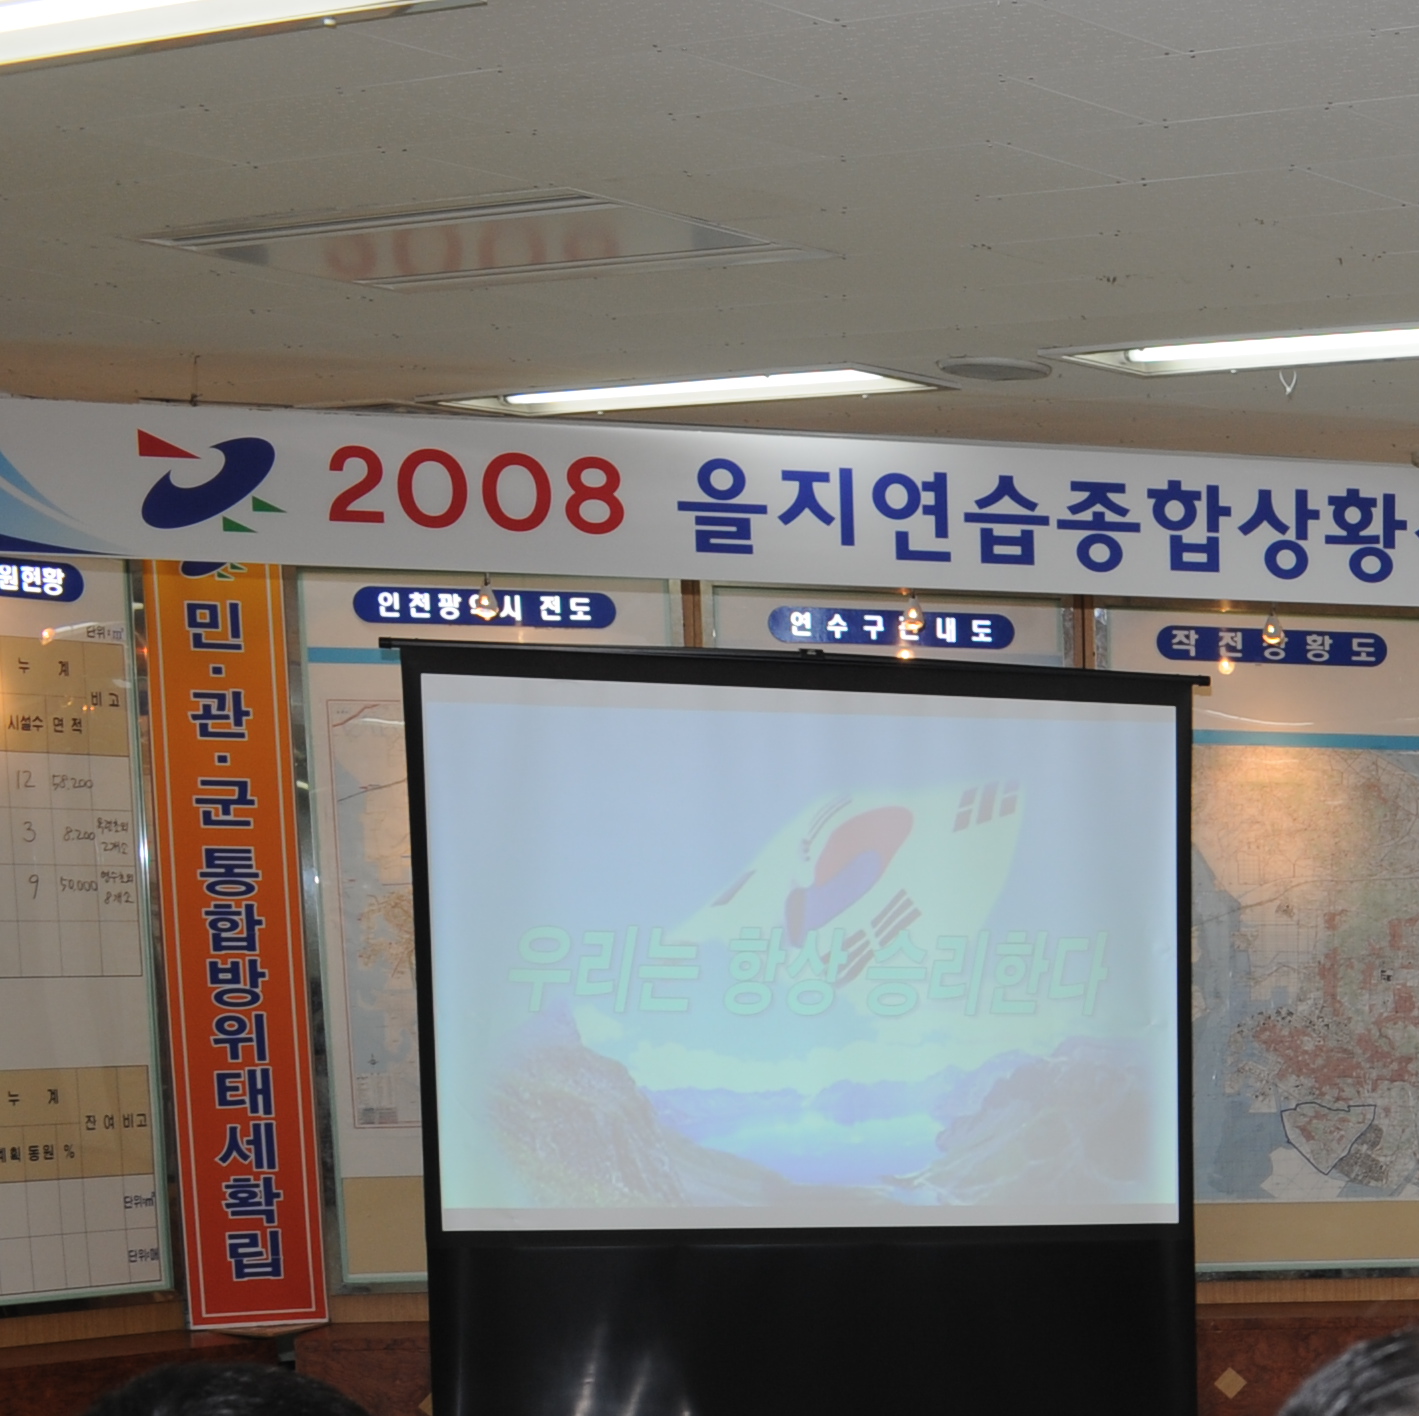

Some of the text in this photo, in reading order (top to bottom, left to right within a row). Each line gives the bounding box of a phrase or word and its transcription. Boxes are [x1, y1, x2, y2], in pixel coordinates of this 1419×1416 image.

[328, 444, 625, 535] 2008
[8, 715, 44, 732] 시설수
[52, 716, 83, 734] 면적
[15, 770, 36, 789] 12
[510, 925, 1108, 1016] 우리는 항상 승리한다
